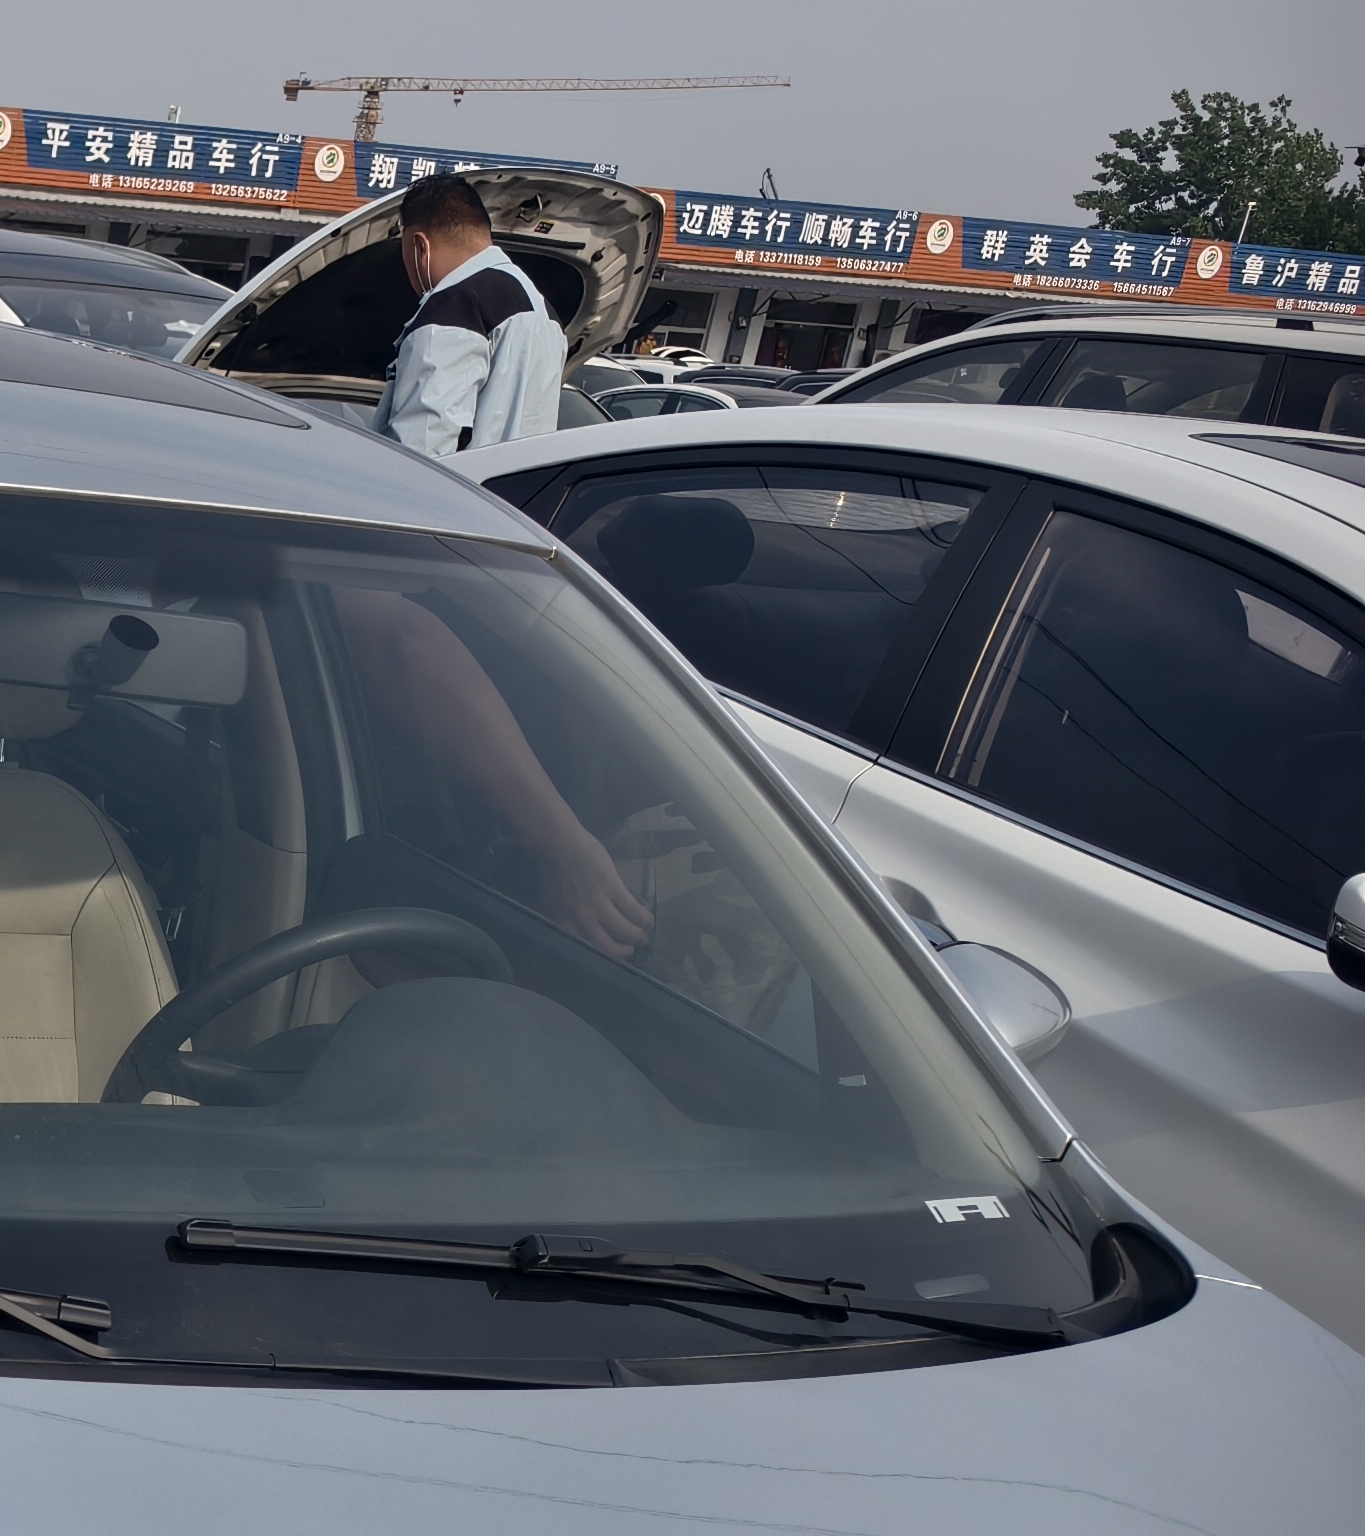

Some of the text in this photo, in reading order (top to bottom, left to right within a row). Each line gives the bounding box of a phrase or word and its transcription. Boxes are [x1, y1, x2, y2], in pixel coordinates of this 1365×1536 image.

[41, 122, 280, 179] 平安精品车行
[276, 133, 303, 145] A9-4
[368, 153, 480, 188] 翔凯
[593, 163, 616, 175] A9-5
[89, 173, 288, 202] 电话 13165229269 13256375622
[680, 203, 910, 253] 迈腾车行 顺畅车行
[895, 210, 919, 222] A9-6
[981, 229, 1177, 278] 群英会车行
[1170, 236, 1192, 247] A9-7
[734, 249, 904, 273] 电话 13371118159 13506327477
[1013, 273, 1032, 287] 电话
[1242, 254, 1361, 295] 鲁沪精品
[1276, 298, 1295, 310] 电话
